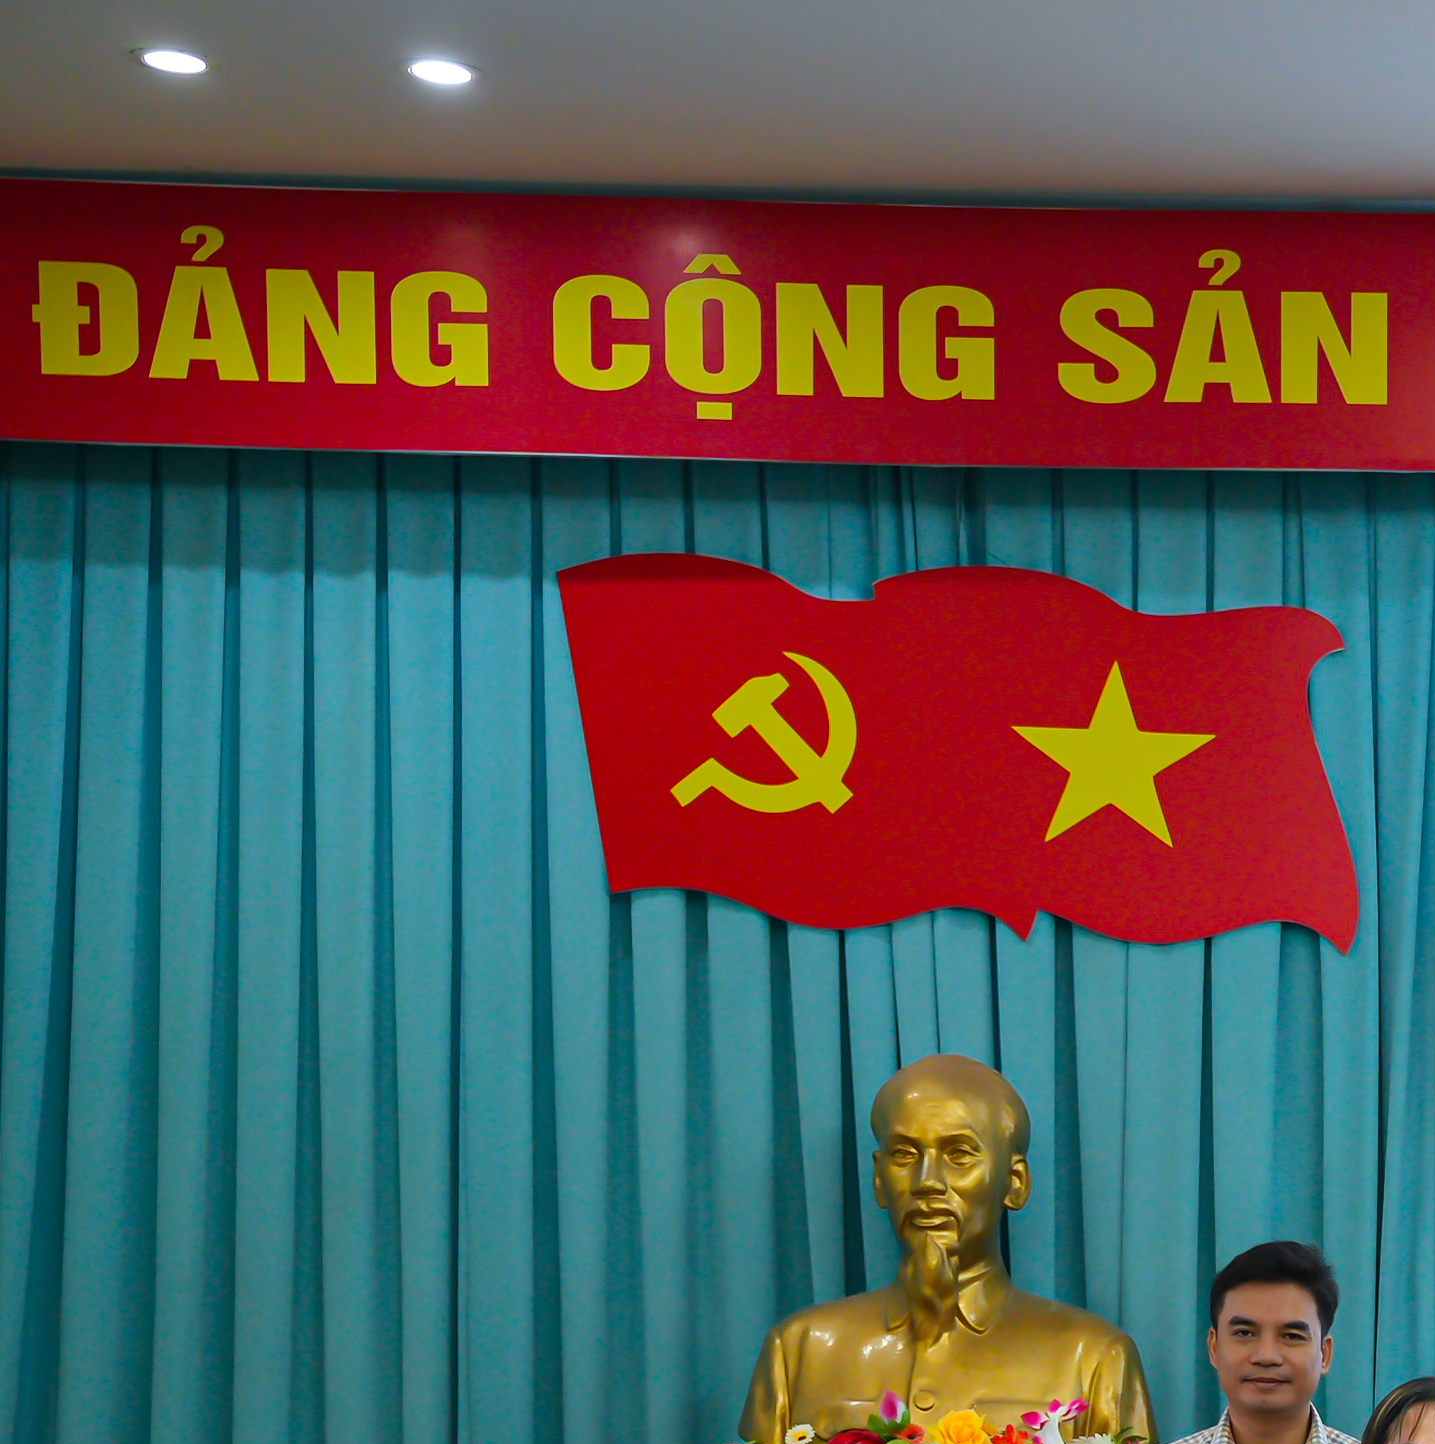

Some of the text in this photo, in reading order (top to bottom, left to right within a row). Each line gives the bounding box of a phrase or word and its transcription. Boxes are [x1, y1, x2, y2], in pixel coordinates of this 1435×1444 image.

[32, 225, 489, 388] ĐẢNG
[552, 253, 996, 421] CỘNG
[1057, 249, 1389, 405] SẢN
